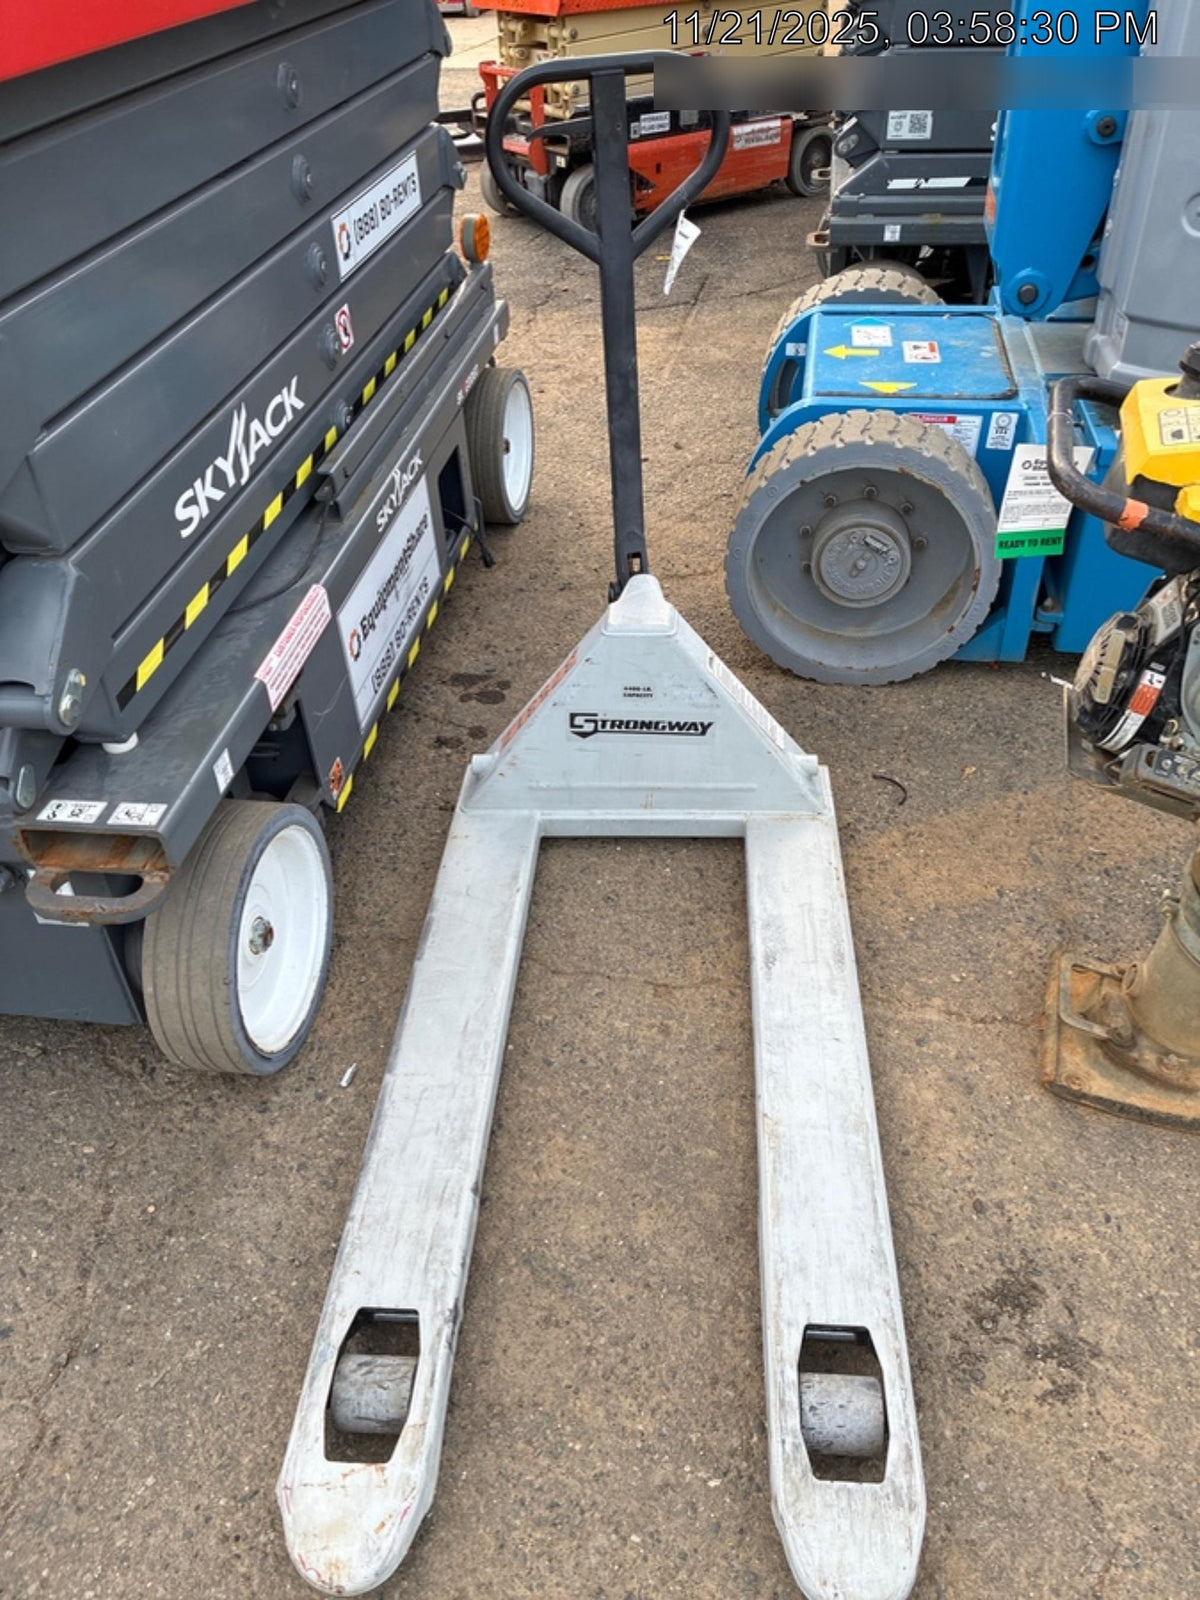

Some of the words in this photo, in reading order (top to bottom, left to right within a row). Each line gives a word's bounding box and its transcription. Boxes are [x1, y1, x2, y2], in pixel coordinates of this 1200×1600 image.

[354, 202, 379, 246] (888)
[379, 172, 417, 220] 80-RENTS
[174, 375, 306, 539] SKYJACK
[376, 448, 423, 532] SKYJACK
[359, 513, 428, 642] EquipmentShare
[998, 540, 1025, 549] READY
[1027, 539, 1037, 547] TO
[1040, 536, 1063, 546] RENT
[569, 713, 714, 737] STRONGWAY
